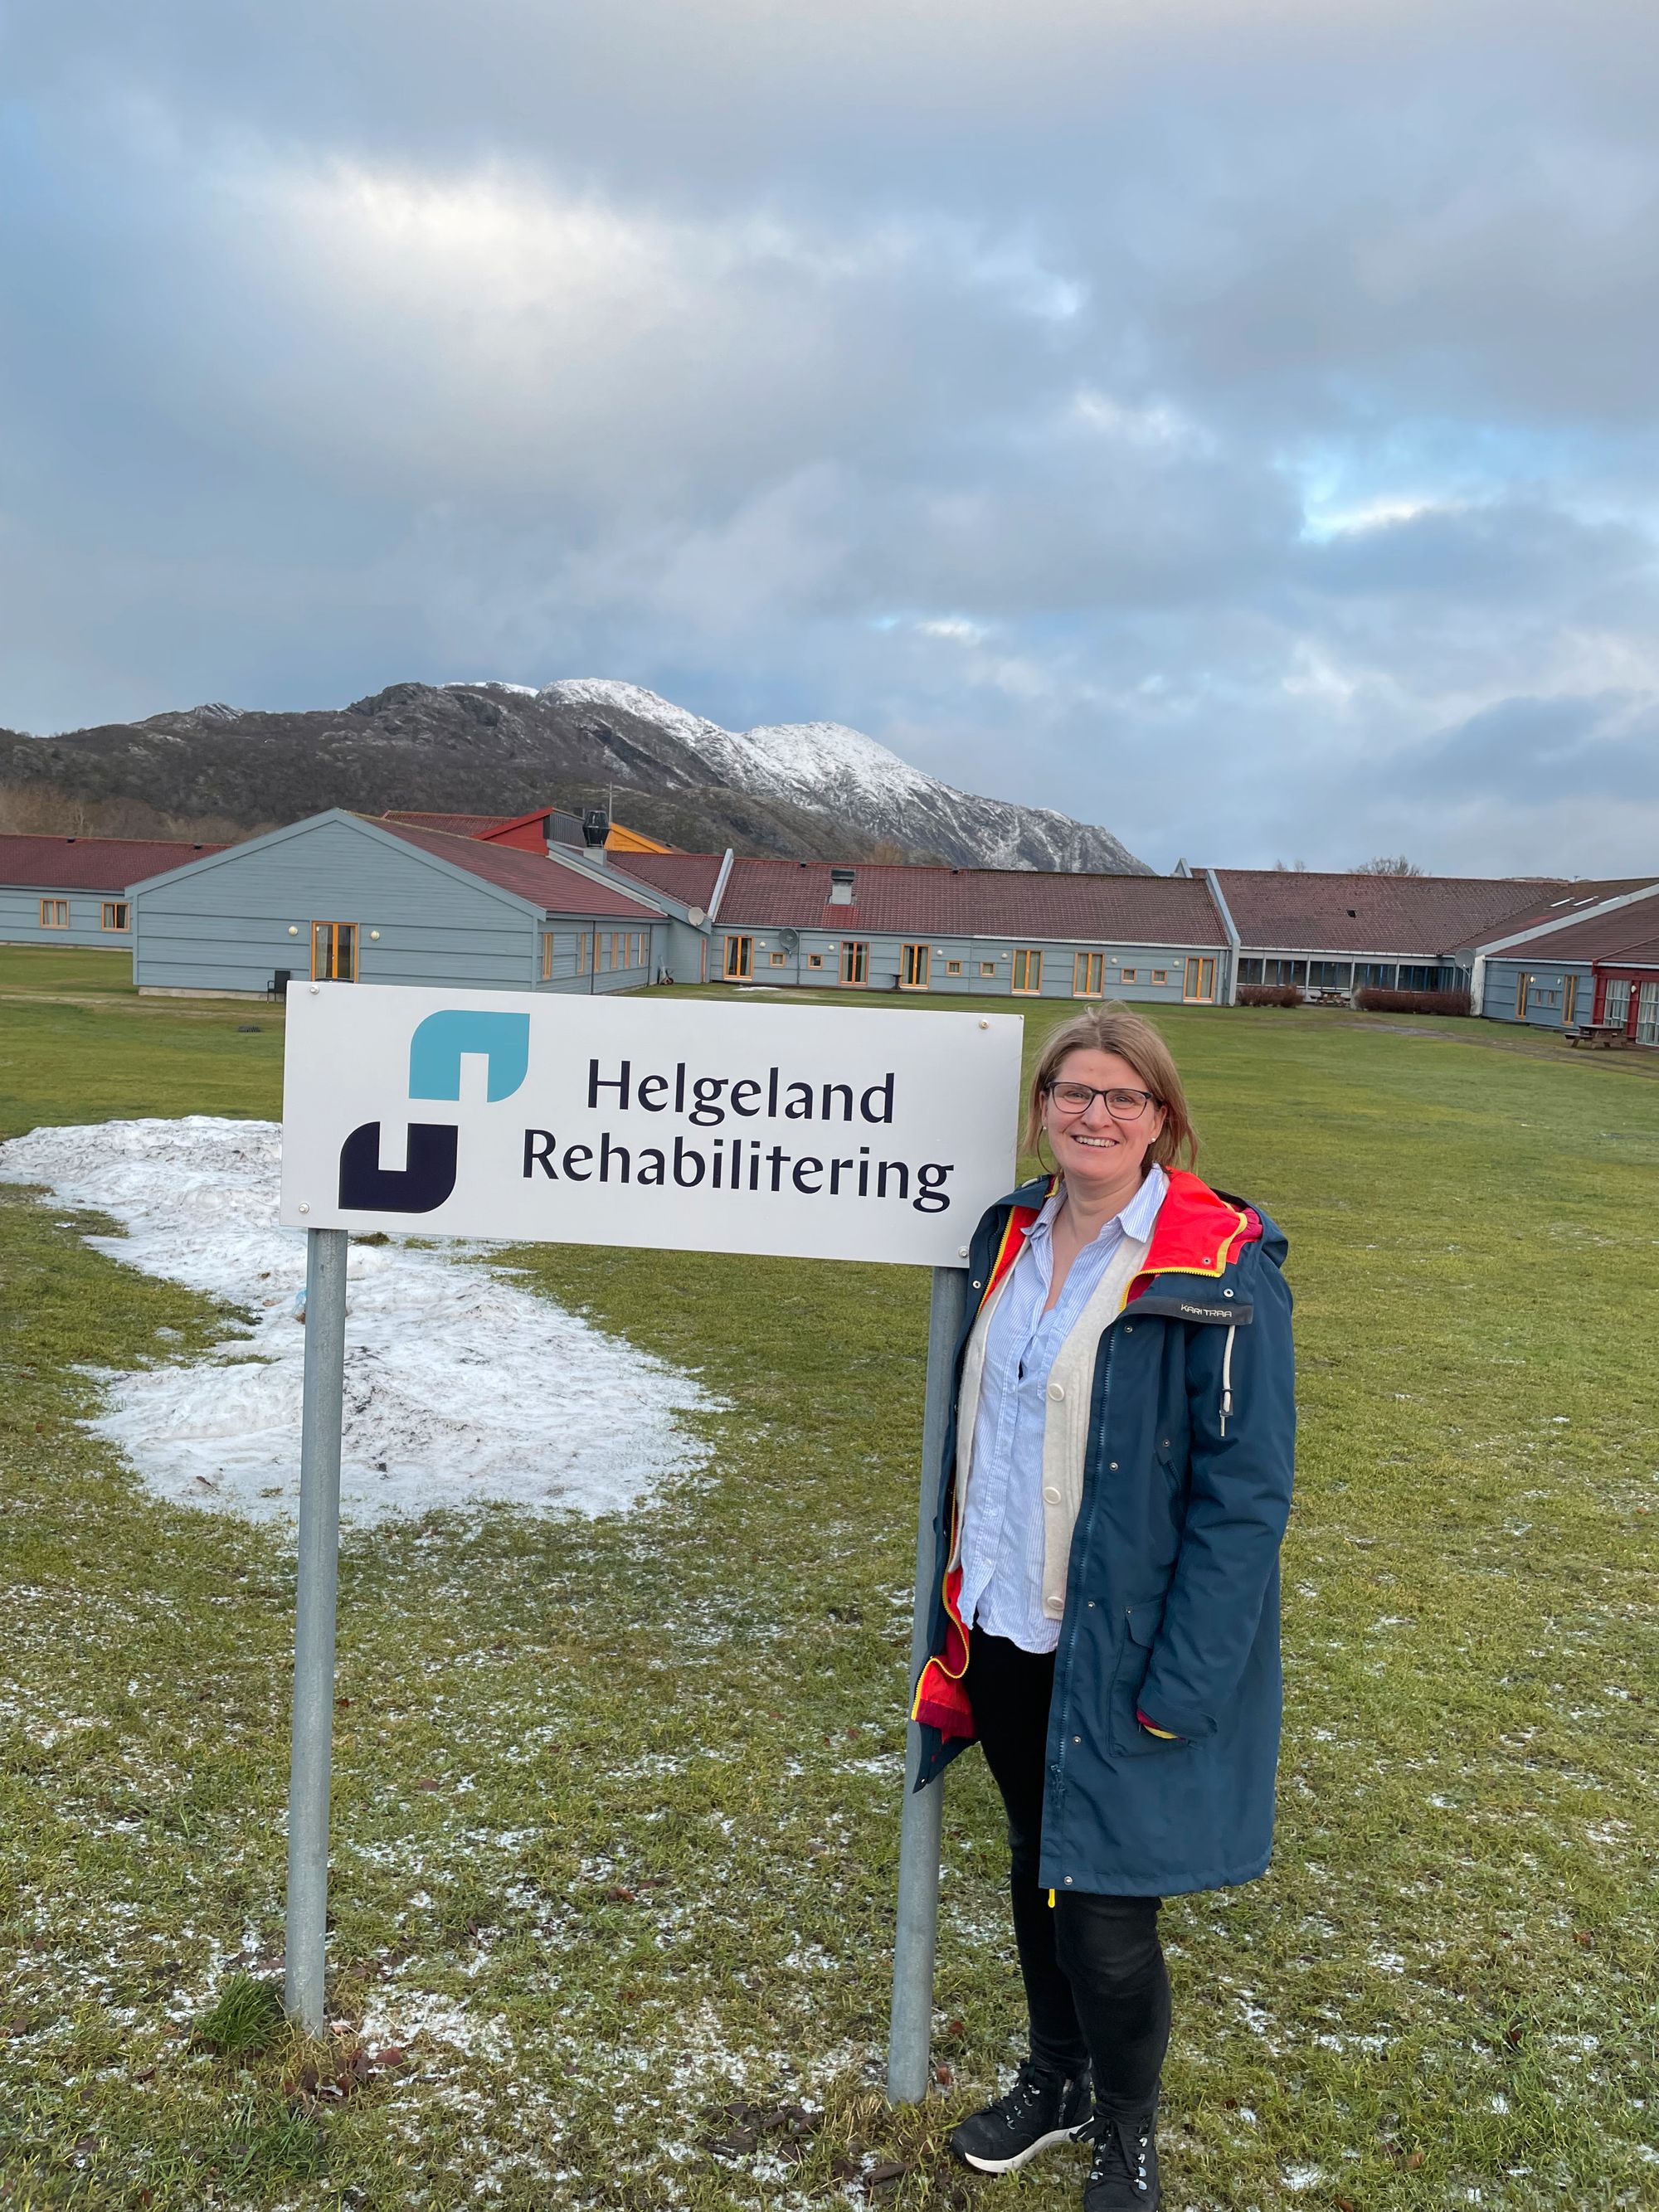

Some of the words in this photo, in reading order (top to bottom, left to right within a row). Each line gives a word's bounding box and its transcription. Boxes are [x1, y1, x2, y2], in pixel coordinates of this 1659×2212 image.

[587, 1058, 895, 1127] Helgeland
[523, 1129, 955, 1213] Rehabilitering
[1180, 1304, 1203, 1315] KARI
[1203, 1309, 1233, 1318] TRAA
